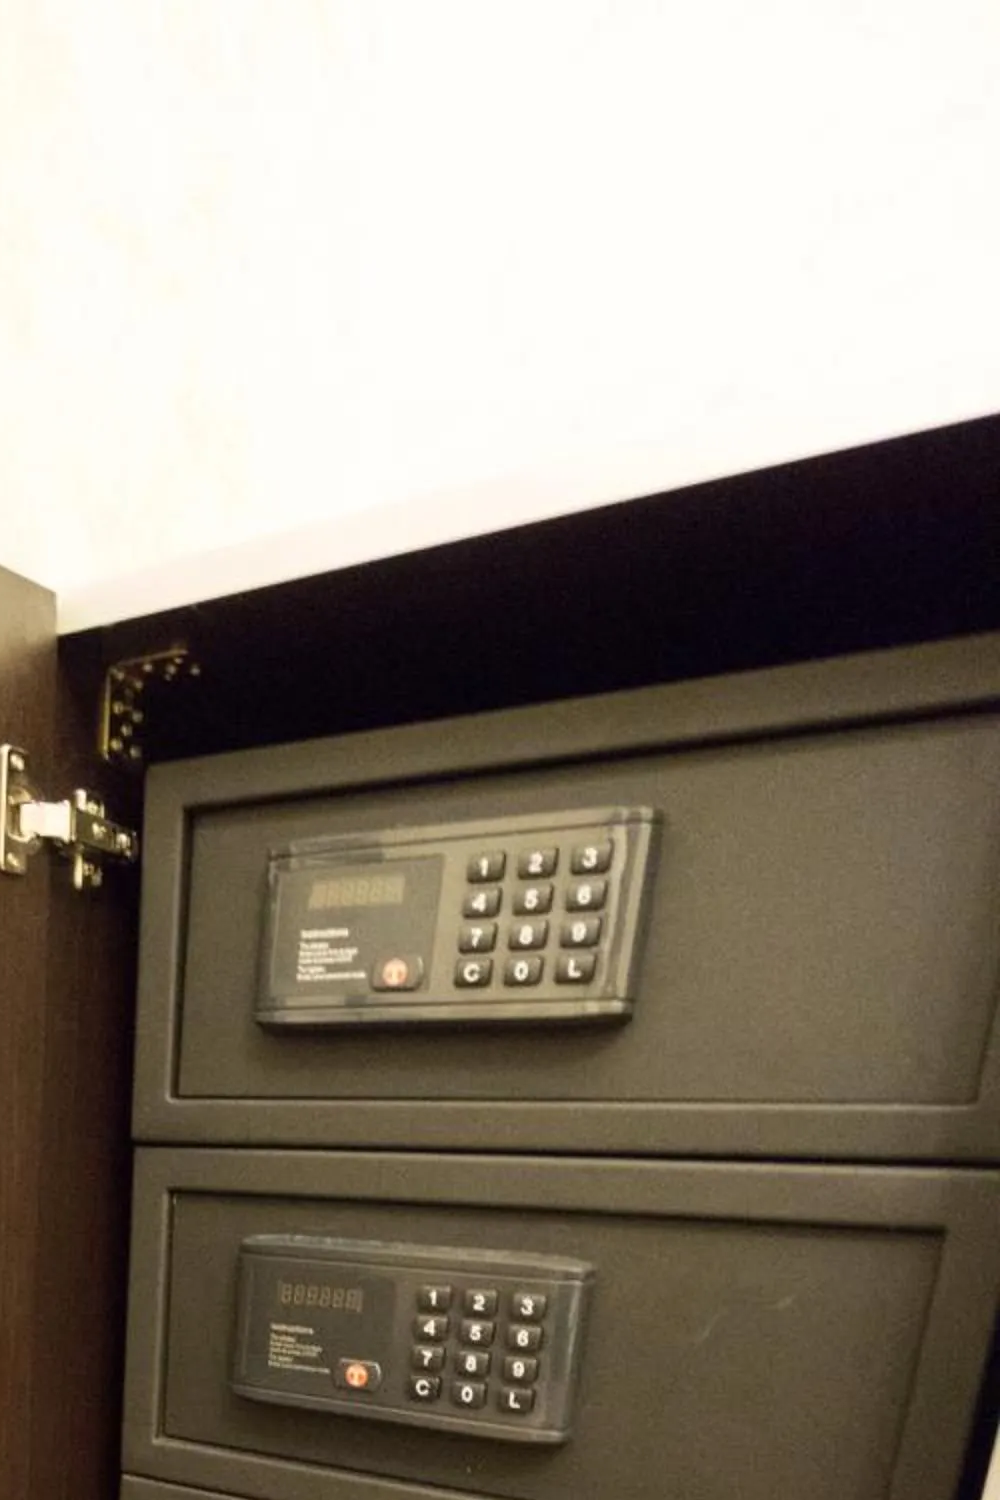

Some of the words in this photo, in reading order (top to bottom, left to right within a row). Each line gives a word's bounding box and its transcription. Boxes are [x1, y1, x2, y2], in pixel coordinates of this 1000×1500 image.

[528, 851, 544, 873] 2
[582, 846, 599, 868] 3
[471, 892, 487, 912] 4
[524, 887, 540, 909] 5
[576, 883, 593, 905] 6
[469, 926, 484, 947] 7
[519, 923, 534, 945] 8
[463, 961, 481, 982] C
[513, 959, 529, 981] 0
[567, 956, 581, 978] L
[473, 1292, 486, 1311] 2
[520, 1295, 534, 1316] 3
[423, 1318, 437, 1336] 4
[469, 1322, 483, 1341] 5
[516, 1328, 529, 1347] 6
[421, 1347, 434, 1366] 7
[465, 1353, 477, 1372] 8
[512, 1360, 525, 1378] 9
[415, 1378, 430, 1396] C
[460, 1384, 474, 1403] 0
[508, 1389, 521, 1409] L
